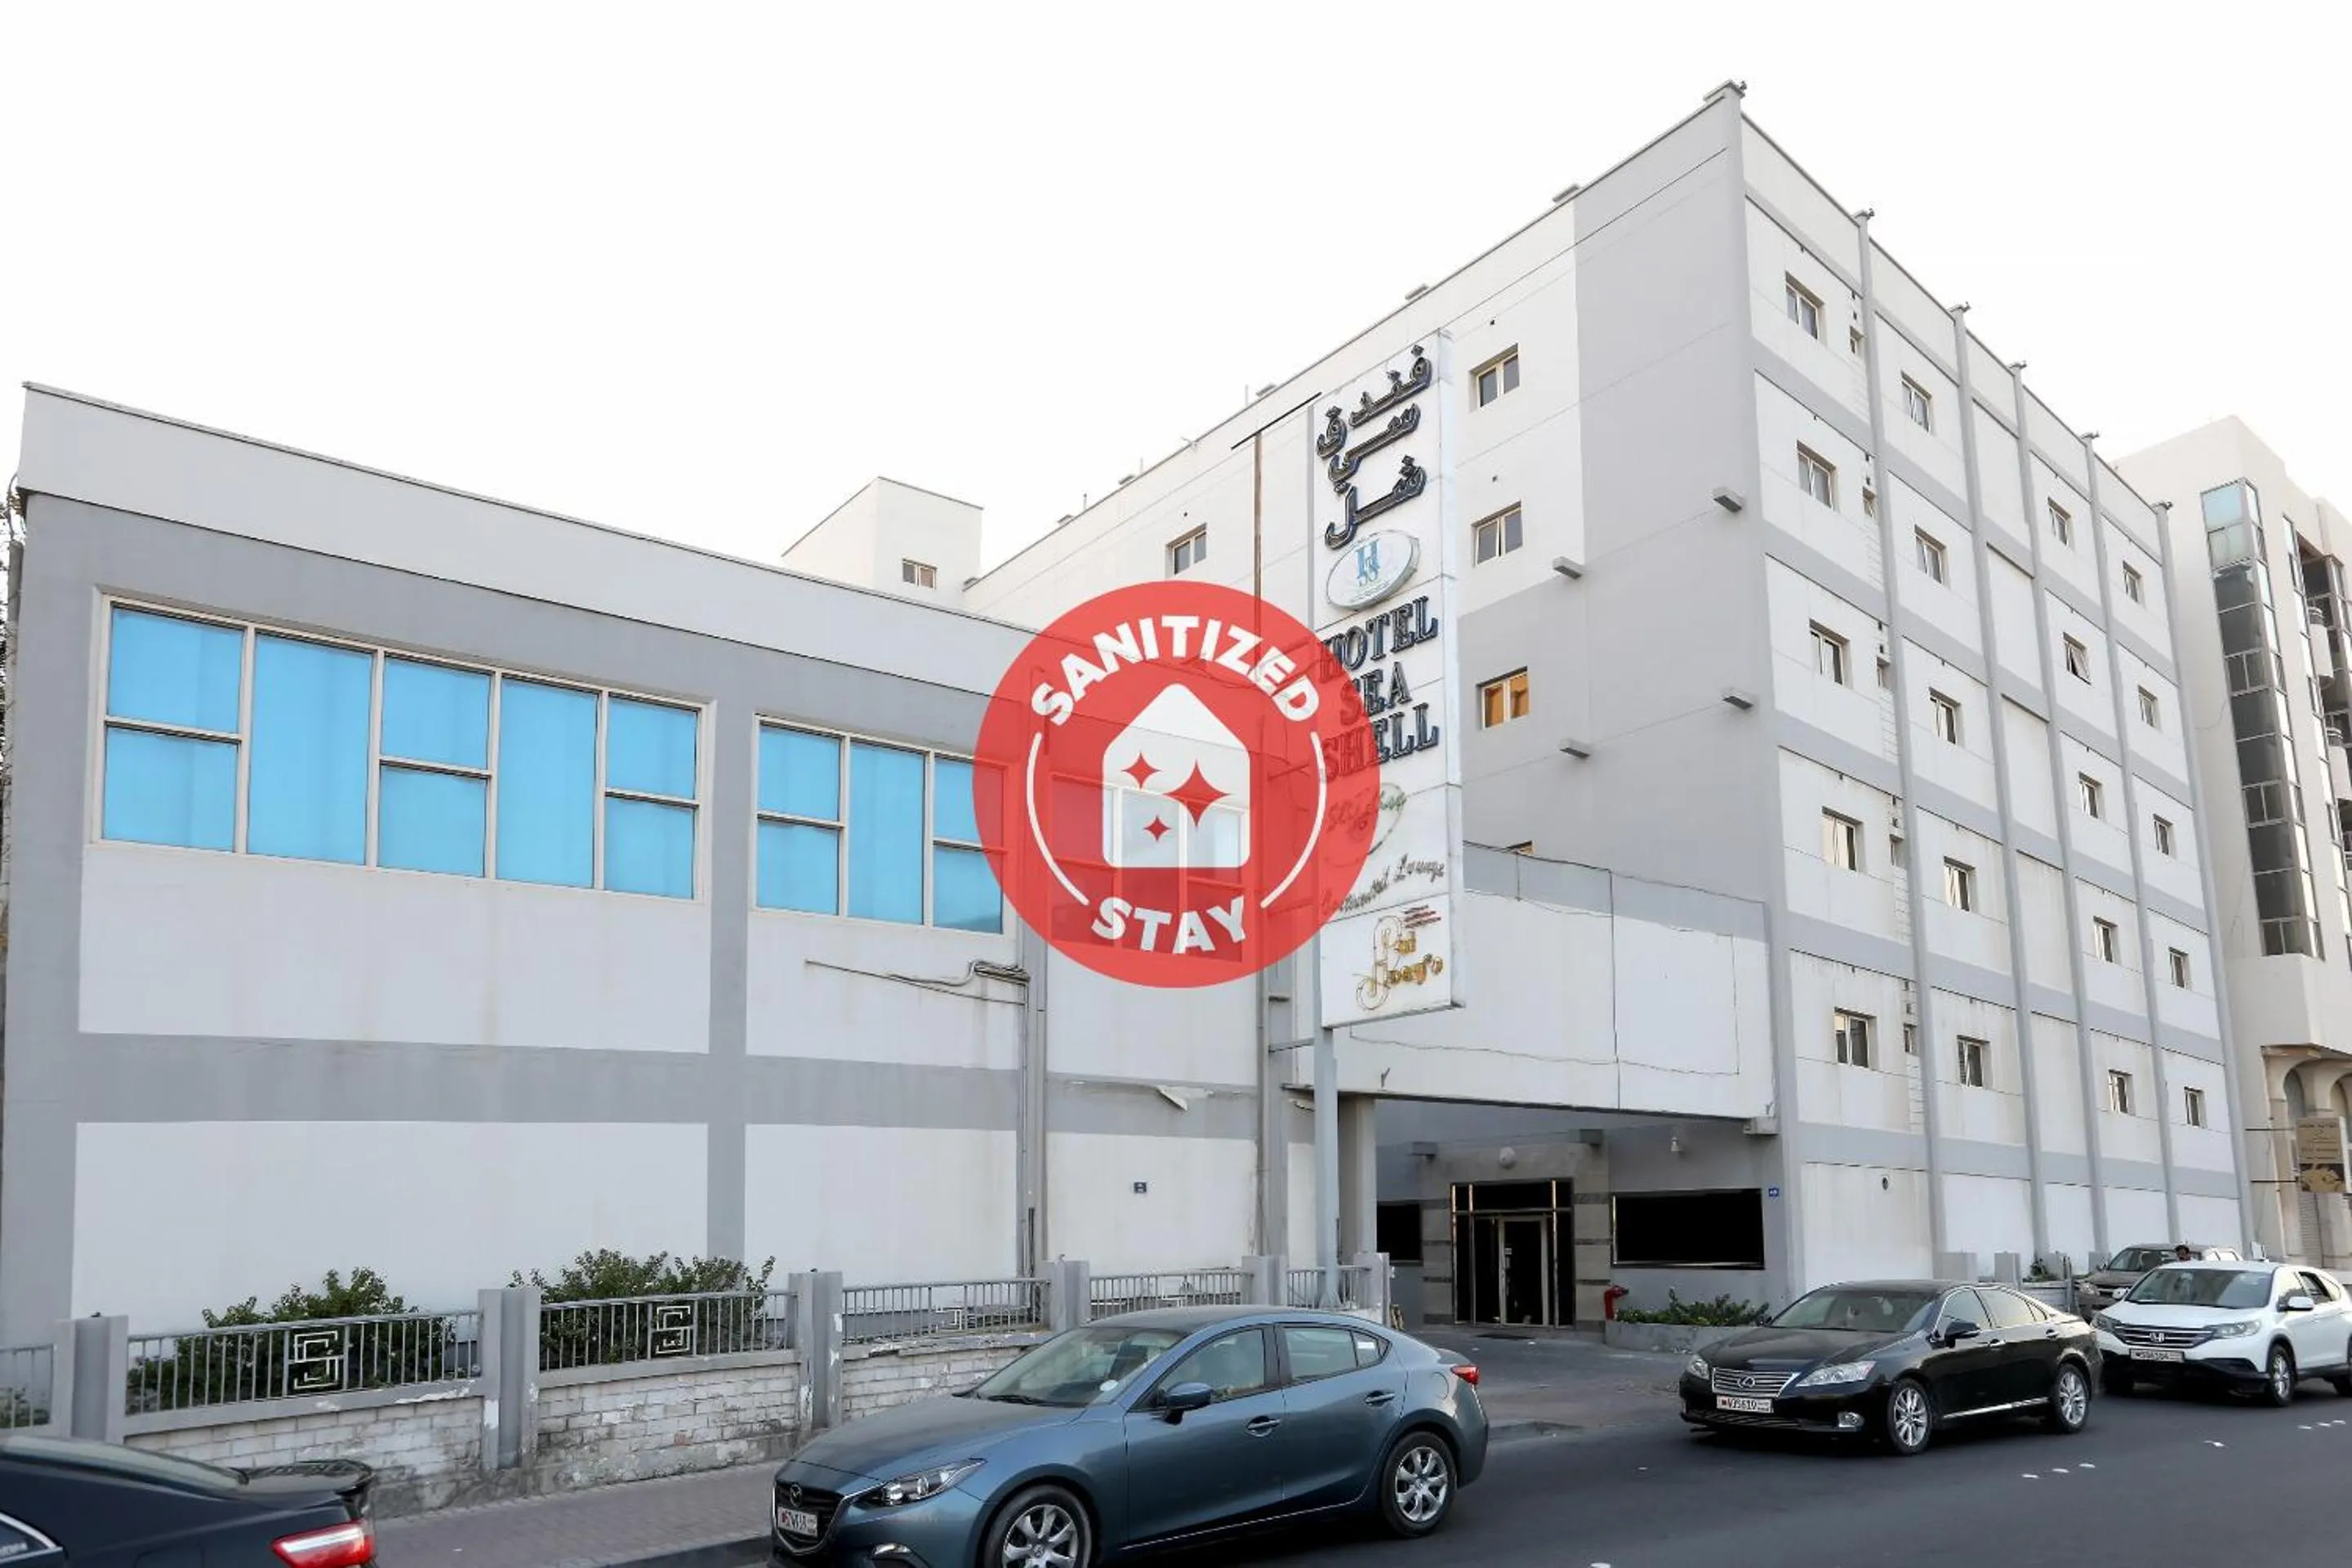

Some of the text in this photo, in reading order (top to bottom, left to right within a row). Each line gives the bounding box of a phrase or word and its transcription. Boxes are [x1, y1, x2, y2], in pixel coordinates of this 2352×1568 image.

[1316, 344, 1432, 460] فندق
[1318, 595, 1439, 684] HOTEL
[1340, 662, 1412, 725] SEA
[1321, 702, 1439, 782] SHELL
